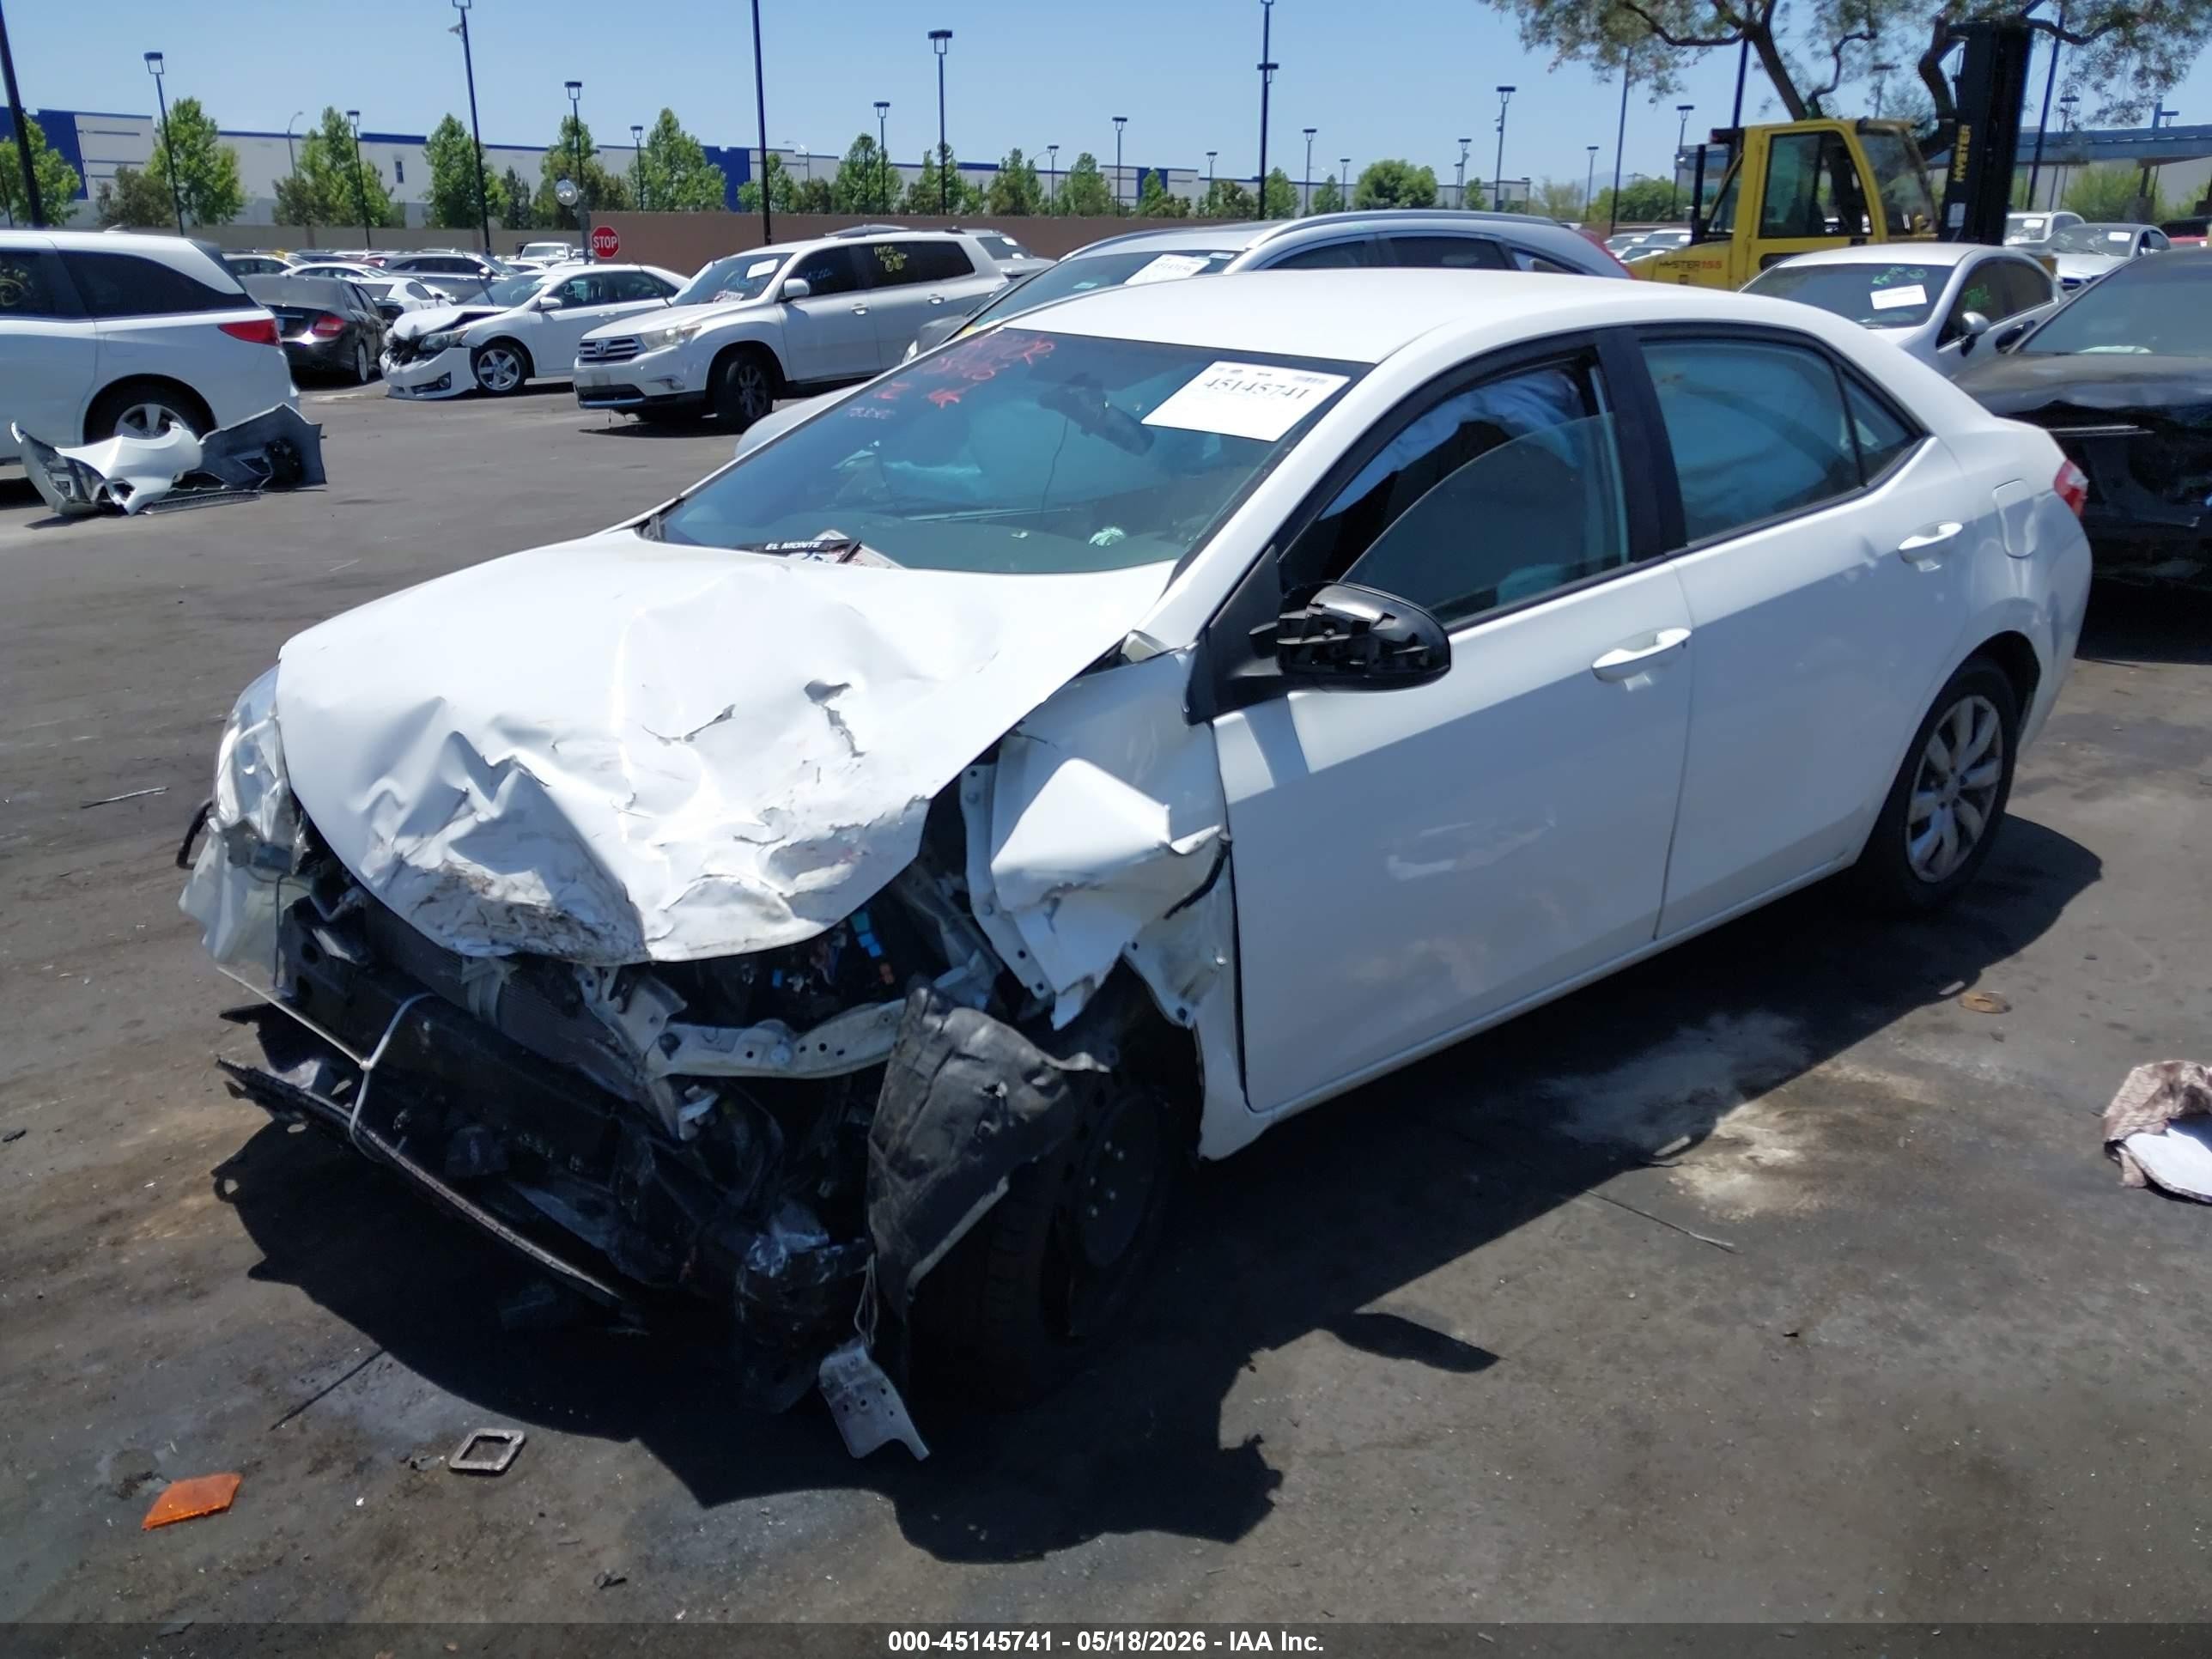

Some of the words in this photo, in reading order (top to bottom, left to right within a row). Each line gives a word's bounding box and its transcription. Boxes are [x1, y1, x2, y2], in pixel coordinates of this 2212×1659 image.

[1954, 125, 1971, 182] HYSTER
[592, 235, 617, 248] STOP
[1205, 378, 1310, 399] 45145741
[781, 541, 822, 550] MONTE
